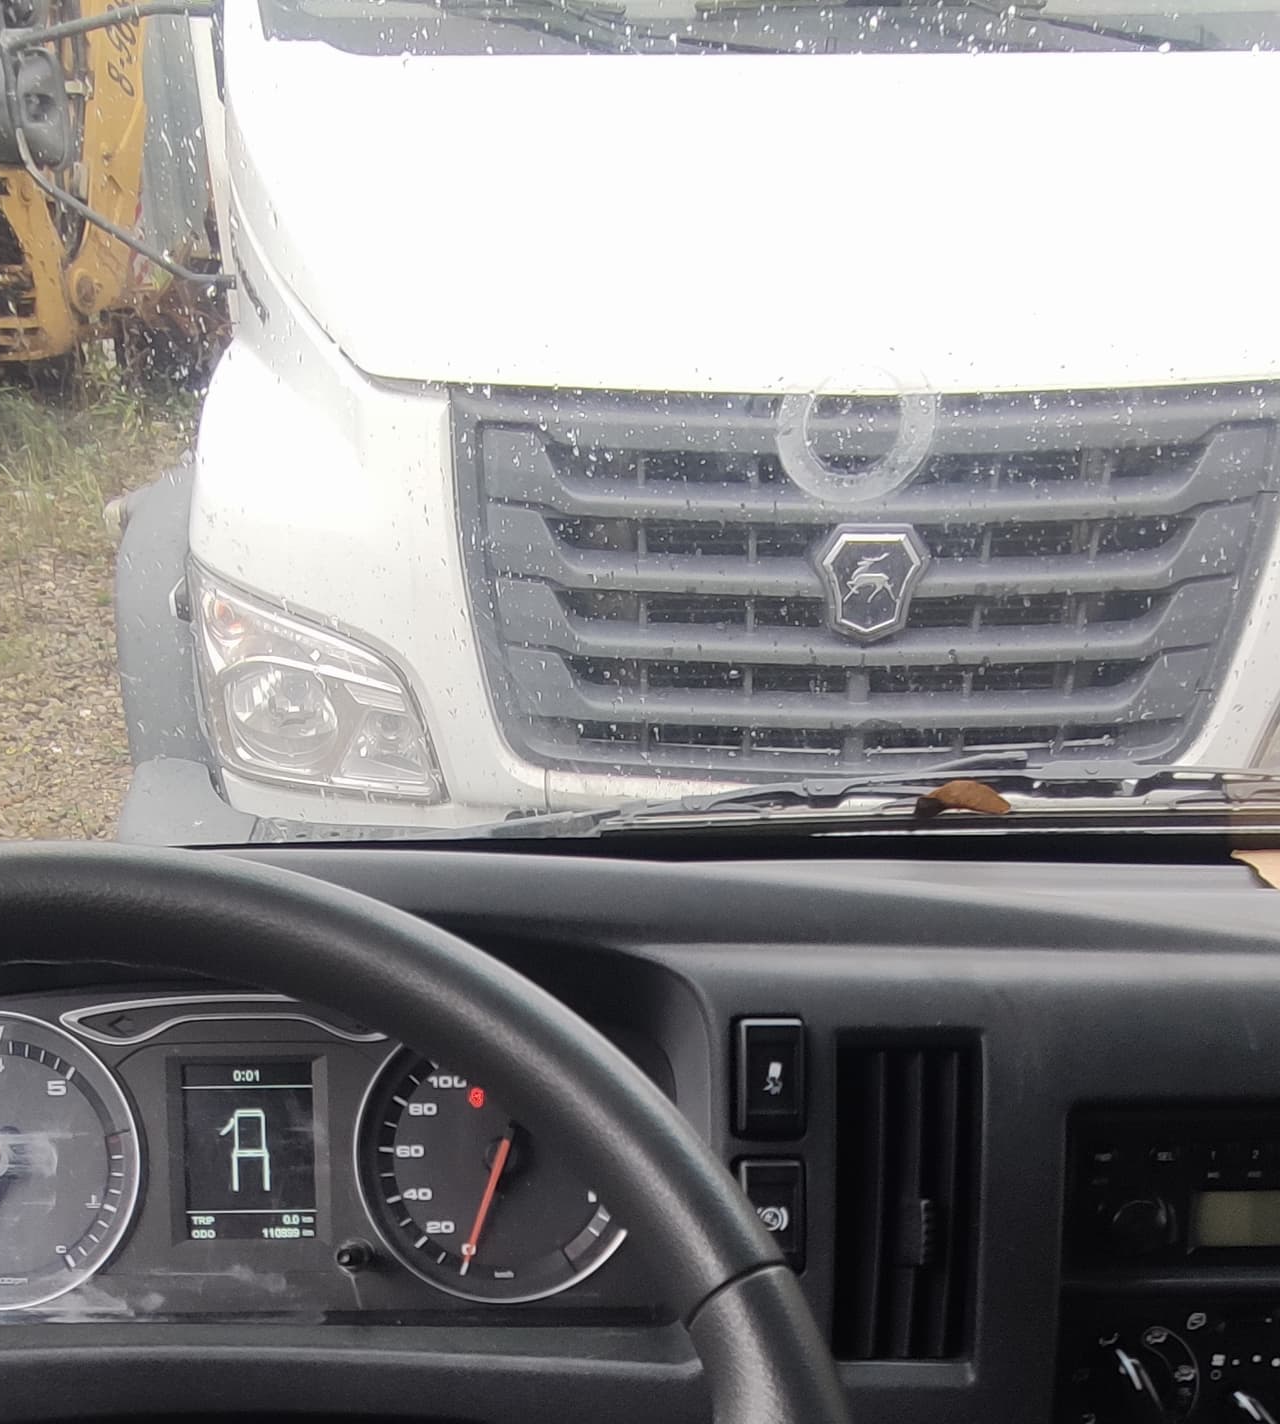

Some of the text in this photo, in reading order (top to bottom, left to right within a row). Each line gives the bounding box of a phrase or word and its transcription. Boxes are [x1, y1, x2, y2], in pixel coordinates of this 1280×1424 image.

[233, 1069, 261, 1082] 0:01
[47, 1079, 68, 1096] 5
[408, 1102, 438, 1116] 80
[395, 1144, 425, 1158] 60
[402, 1187, 433, 1201] 40
[191, 1228, 217, 1239] ODO
[425, 1220, 456, 1234] 20
